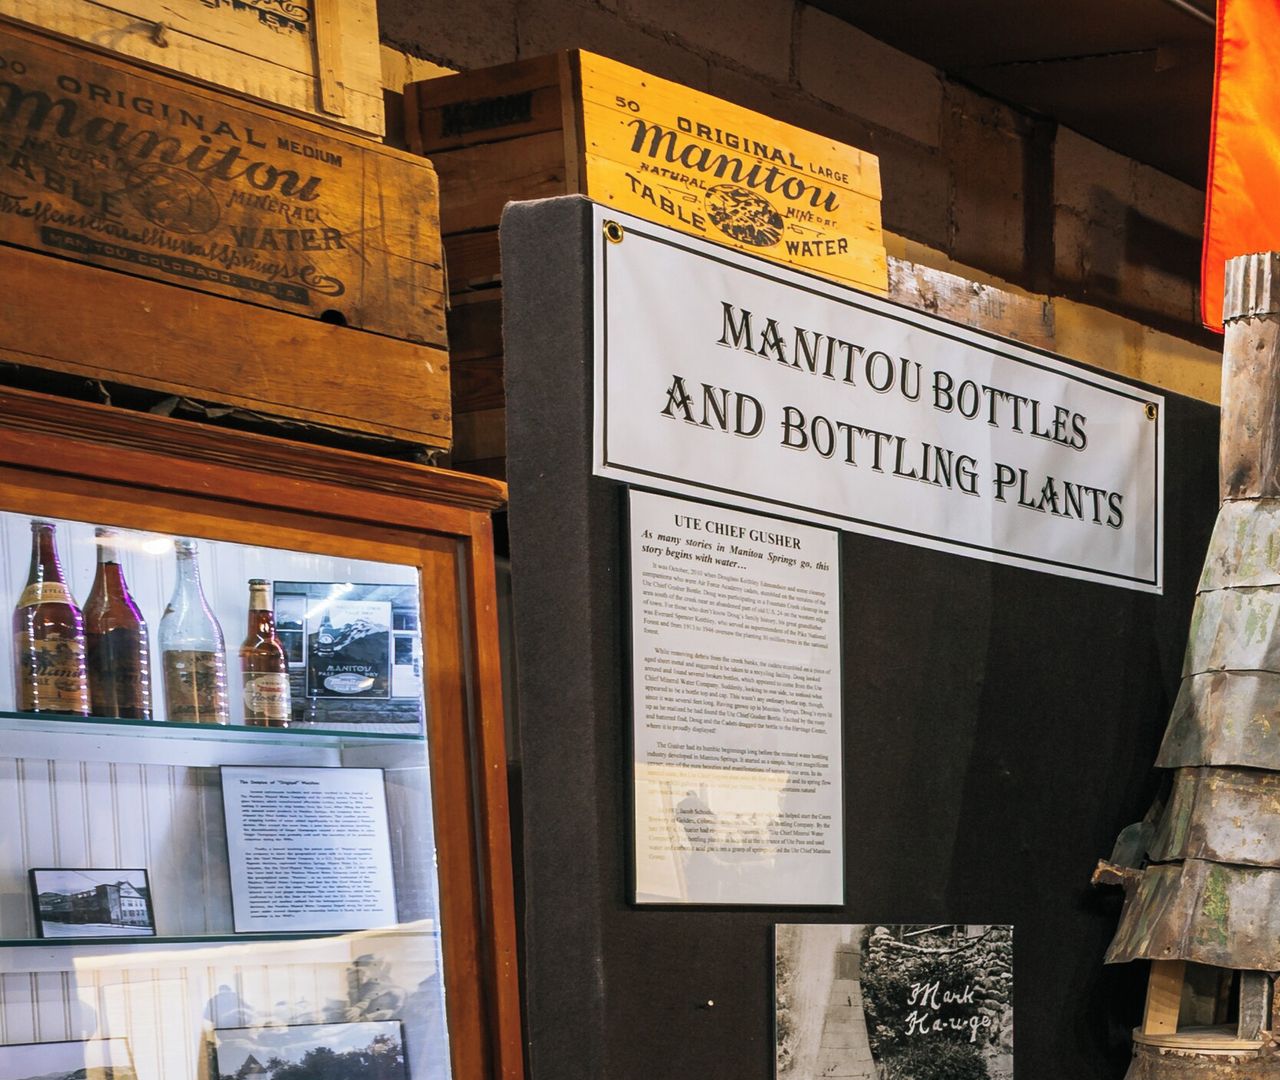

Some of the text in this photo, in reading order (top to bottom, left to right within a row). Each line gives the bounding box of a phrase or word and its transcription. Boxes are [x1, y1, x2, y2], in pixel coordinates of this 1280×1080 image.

[57, 74, 343, 168] ORIGINAL MEDIUM
[615, 96, 641, 113] 50
[639, 162, 713, 191] NATURAL
[677, 116, 849, 184] ORIGINAL LARGE
[0, 145, 348, 252] ABLE WATER
[624, 172, 849, 257] TABLE WATER
[716, 301, 1089, 452] MANITOU BOTTLES
[660, 374, 1126, 530] AND BOTTLING PLANTS
[641, 529, 653, 539] As
[657, 533, 681, 545] many
[685, 538, 712, 550] stories
[716, 543, 725, 552] in
[729, 544, 764, 560] Manitou
[767, 552, 797, 567] Springs
[816, 561, 830, 571] this
[641, 544, 663, 556] story
[665, 547, 693, 561] begins
[695, 552, 713, 564] with
[674, 514, 802, 550] UTE CHIEF GUSHER
[907, 980, 975, 1010] Mark
